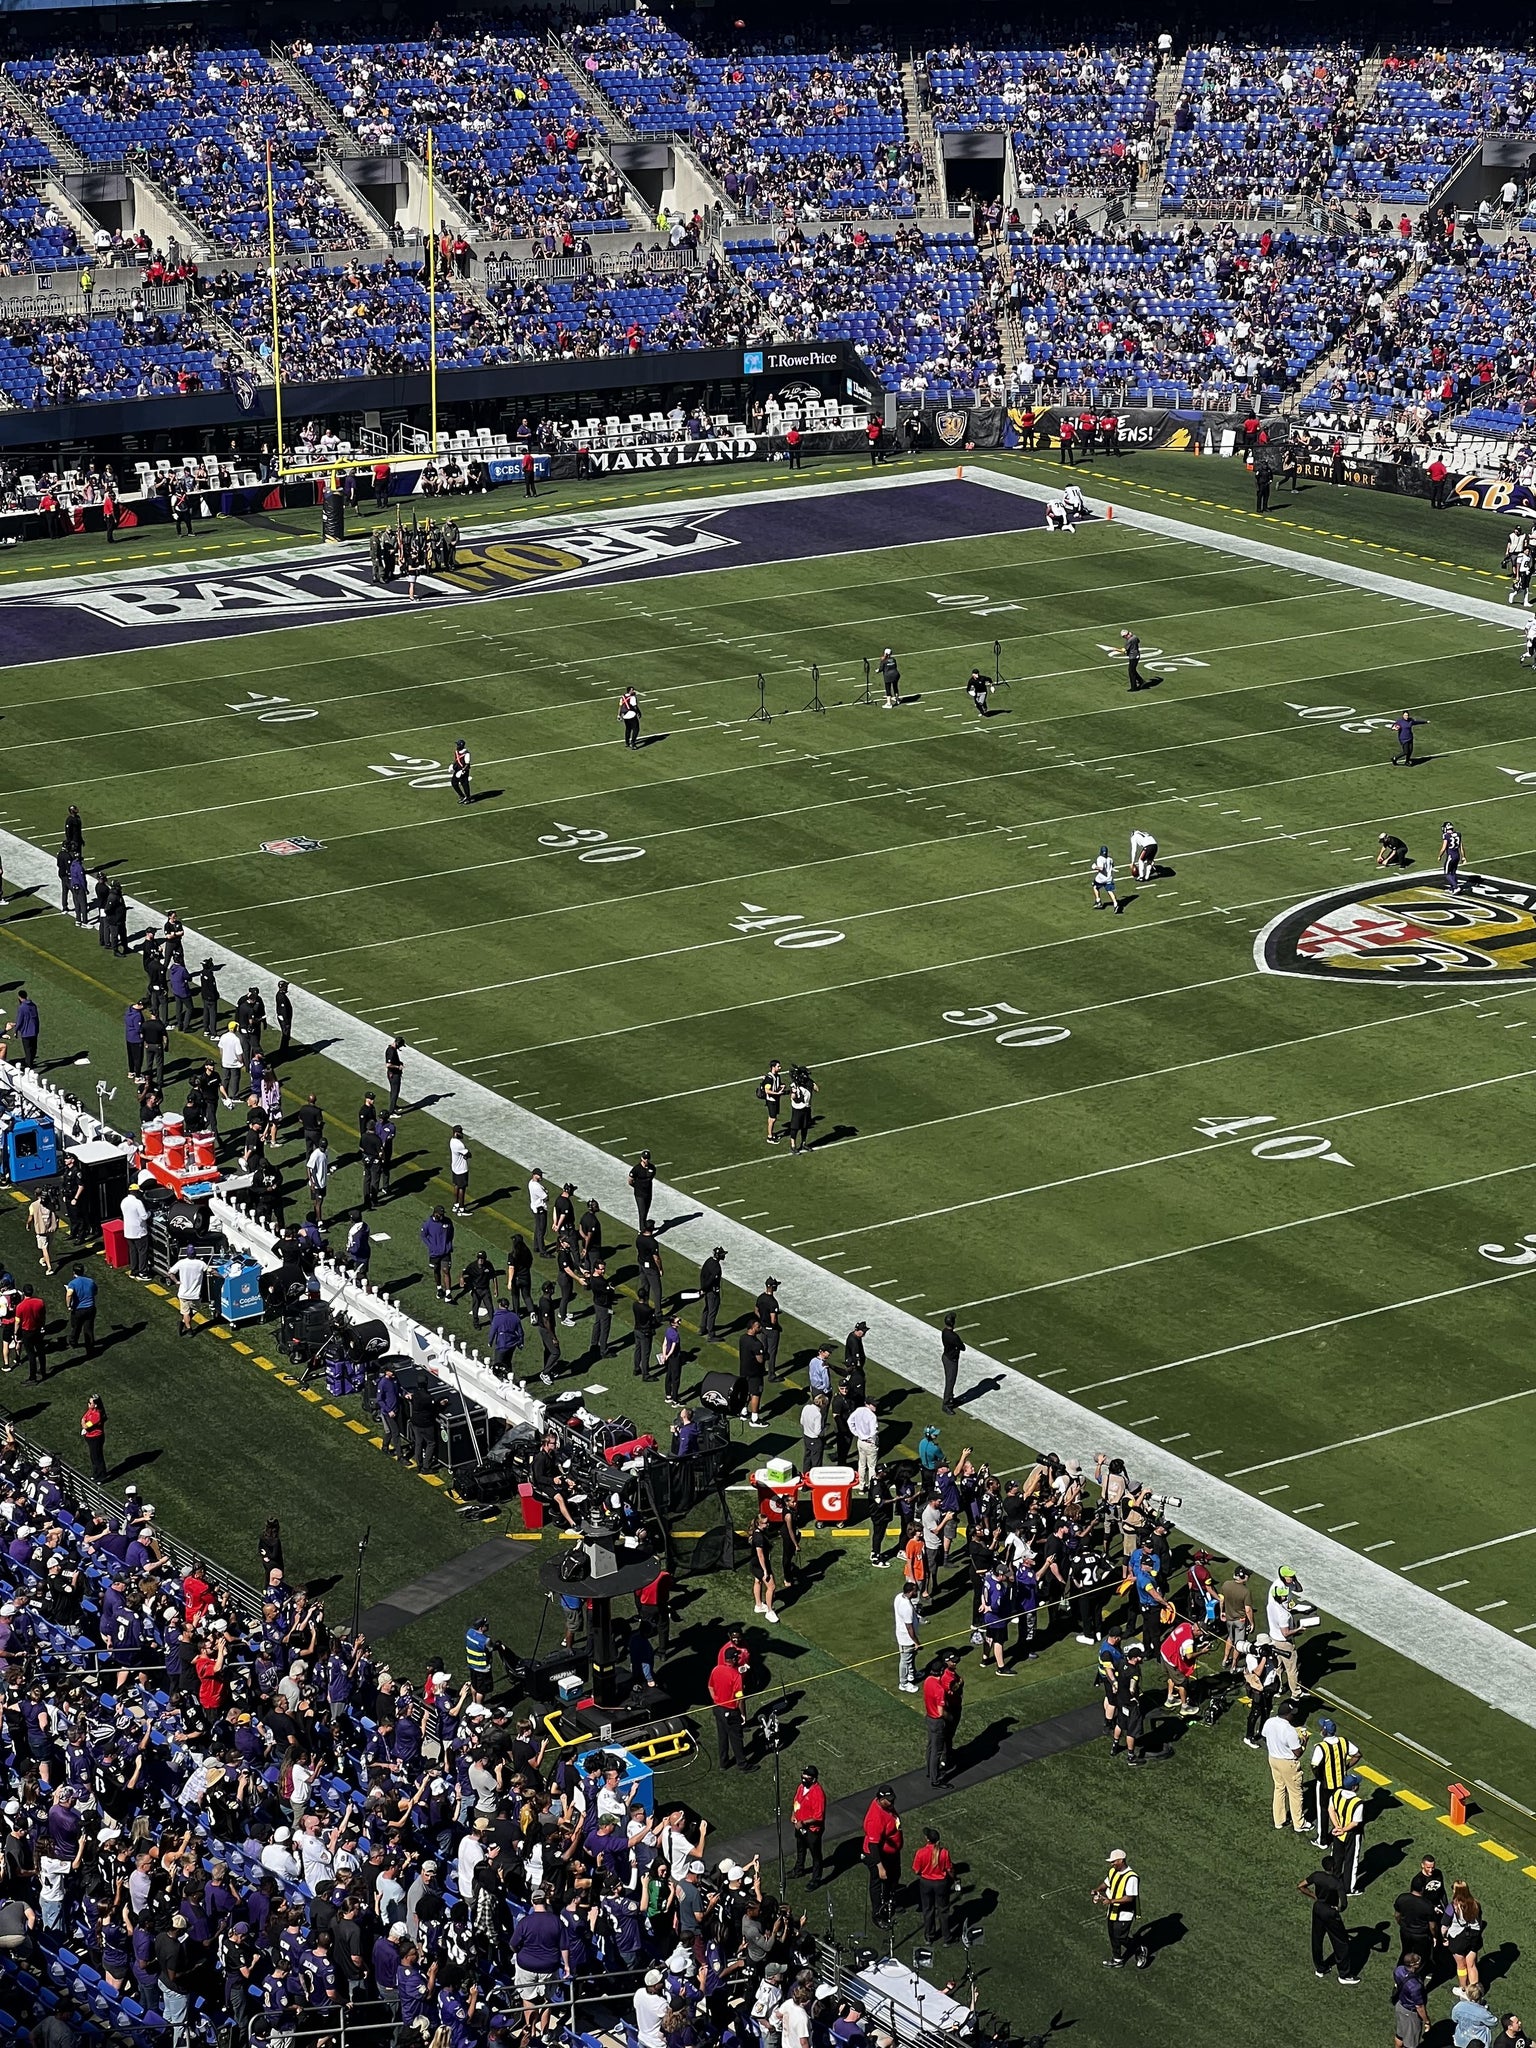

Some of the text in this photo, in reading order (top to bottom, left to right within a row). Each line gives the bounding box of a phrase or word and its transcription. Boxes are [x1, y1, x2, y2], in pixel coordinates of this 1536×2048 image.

[312, 255, 324, 267] 141
[38, 276, 52, 289] 140
[501, 464, 520, 475] CBS
[588, 438, 758, 474] MARYLAND
[225, 696, 319, 723] 10
[367, 756, 473, 789] 20
[537, 827, 647, 864] 30
[1449, 836, 1460, 849] 33
[728, 913, 847, 949] 40
[941, 1001, 1072, 1047] 50
[1191, 1115, 1333, 1160] 40
[821, 1491, 842, 1512] G
[118, 1624, 125, 1641] 8
